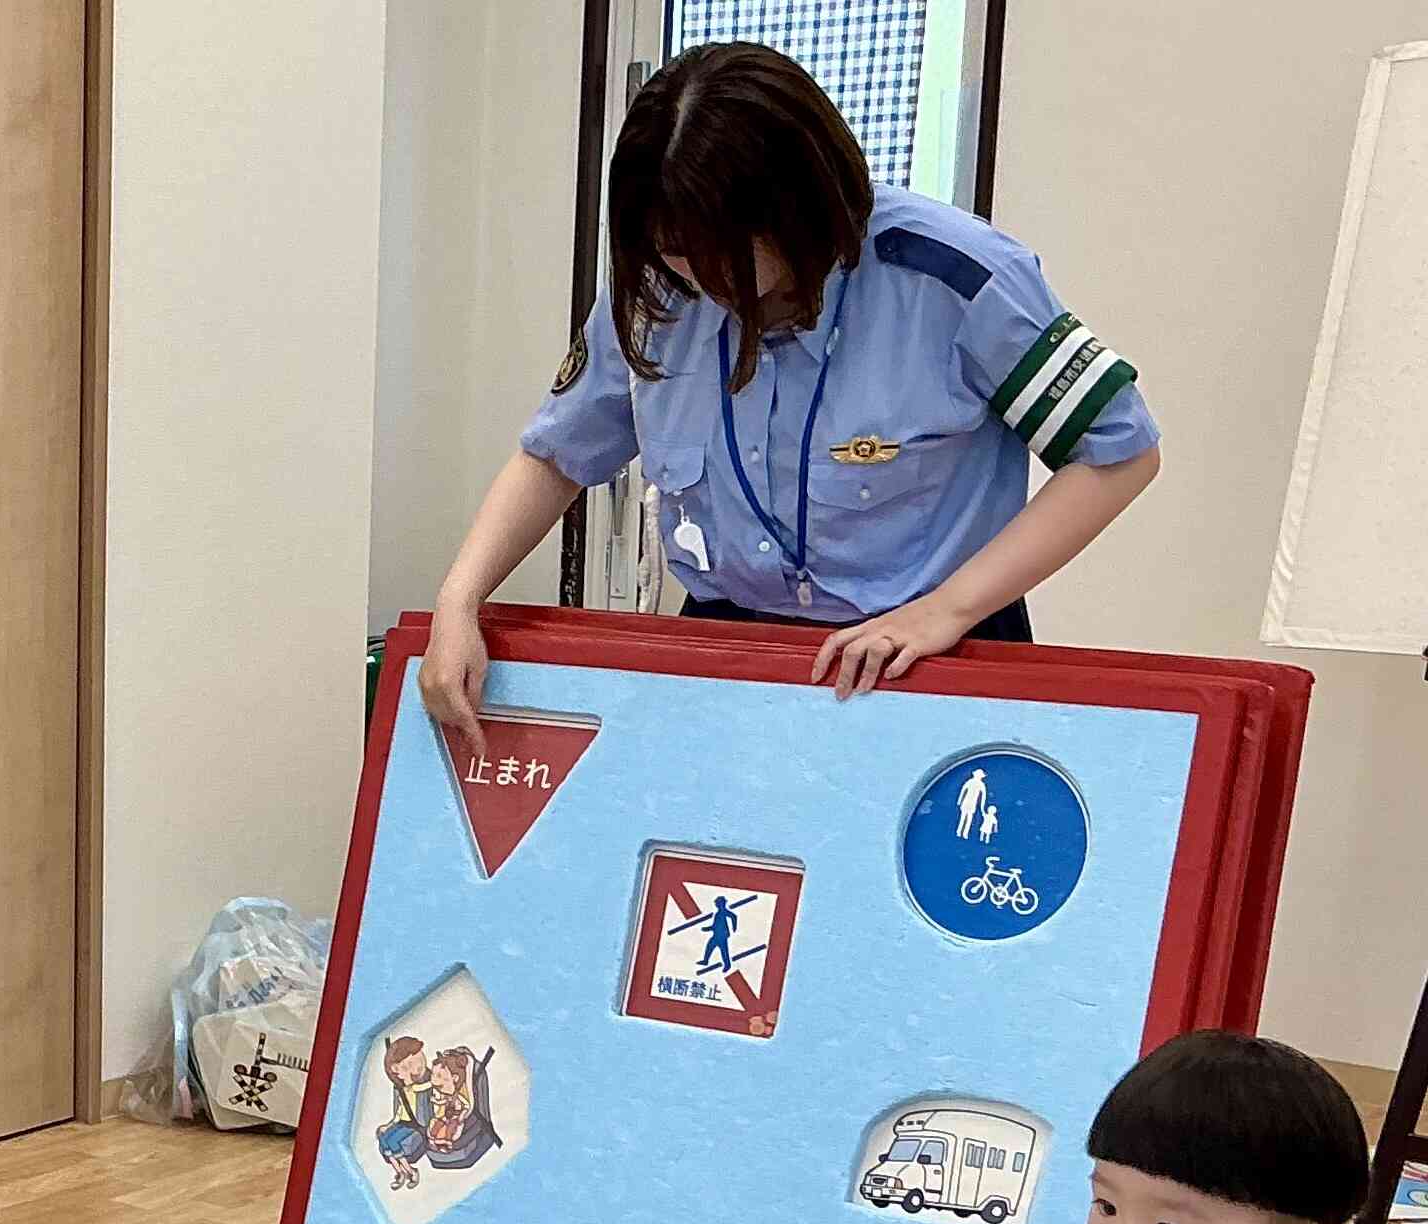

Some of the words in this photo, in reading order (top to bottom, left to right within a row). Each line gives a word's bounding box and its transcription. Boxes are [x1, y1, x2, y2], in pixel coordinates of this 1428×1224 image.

[464, 755, 552, 789] 止まれ
[657, 975, 722, 1002] 横断禁止
